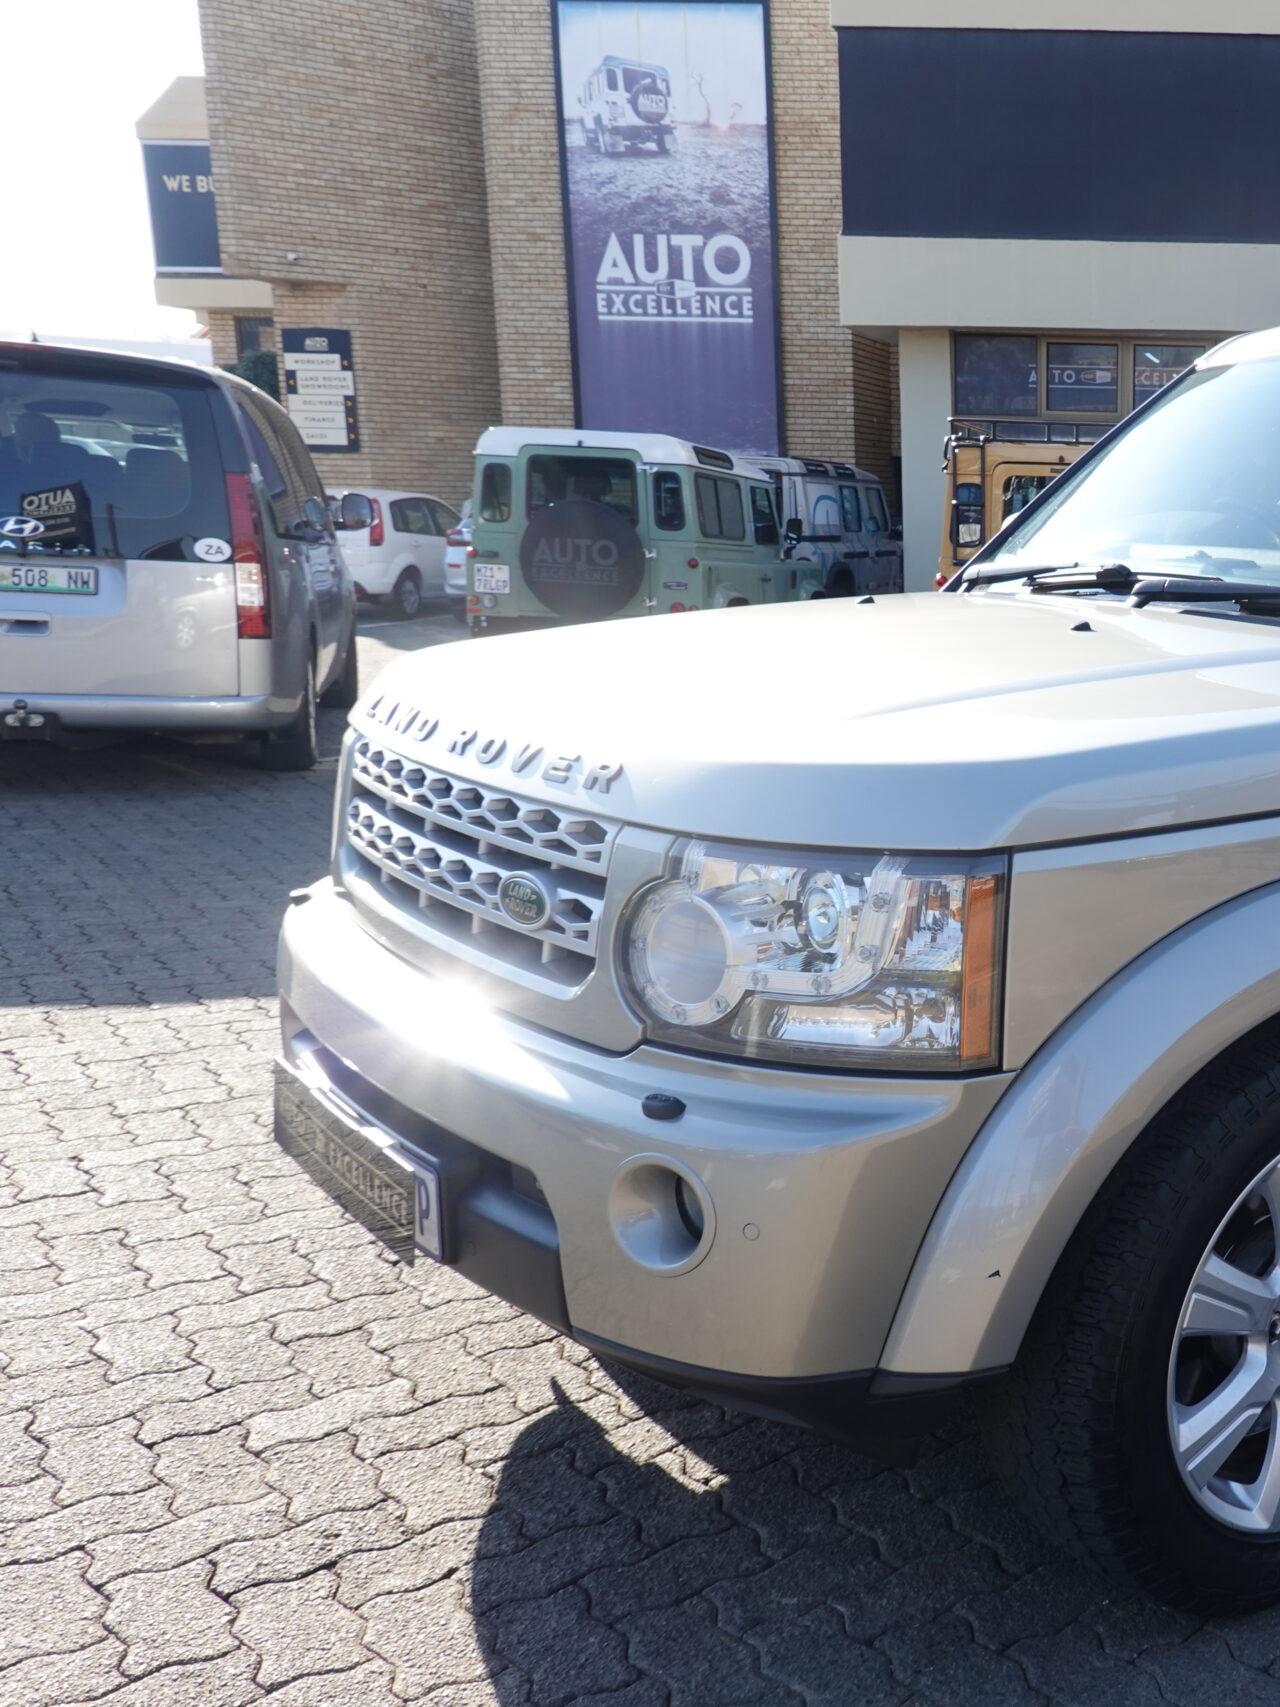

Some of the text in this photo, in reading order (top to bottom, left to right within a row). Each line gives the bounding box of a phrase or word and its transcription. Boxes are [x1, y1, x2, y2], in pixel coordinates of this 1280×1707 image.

[162, 174, 193, 193] WE
[596, 231, 752, 286] AUTO
[596, 293, 754, 316] EXCELLENCE
[1028, 369, 1077, 384] ATO
[204, 543, 225, 557] ZA
[533, 537, 619, 567] AUTO
[11, 567, 49, 588] 508
[447, 730, 624, 794] ROVER
[417, 1177, 431, 1237] P
